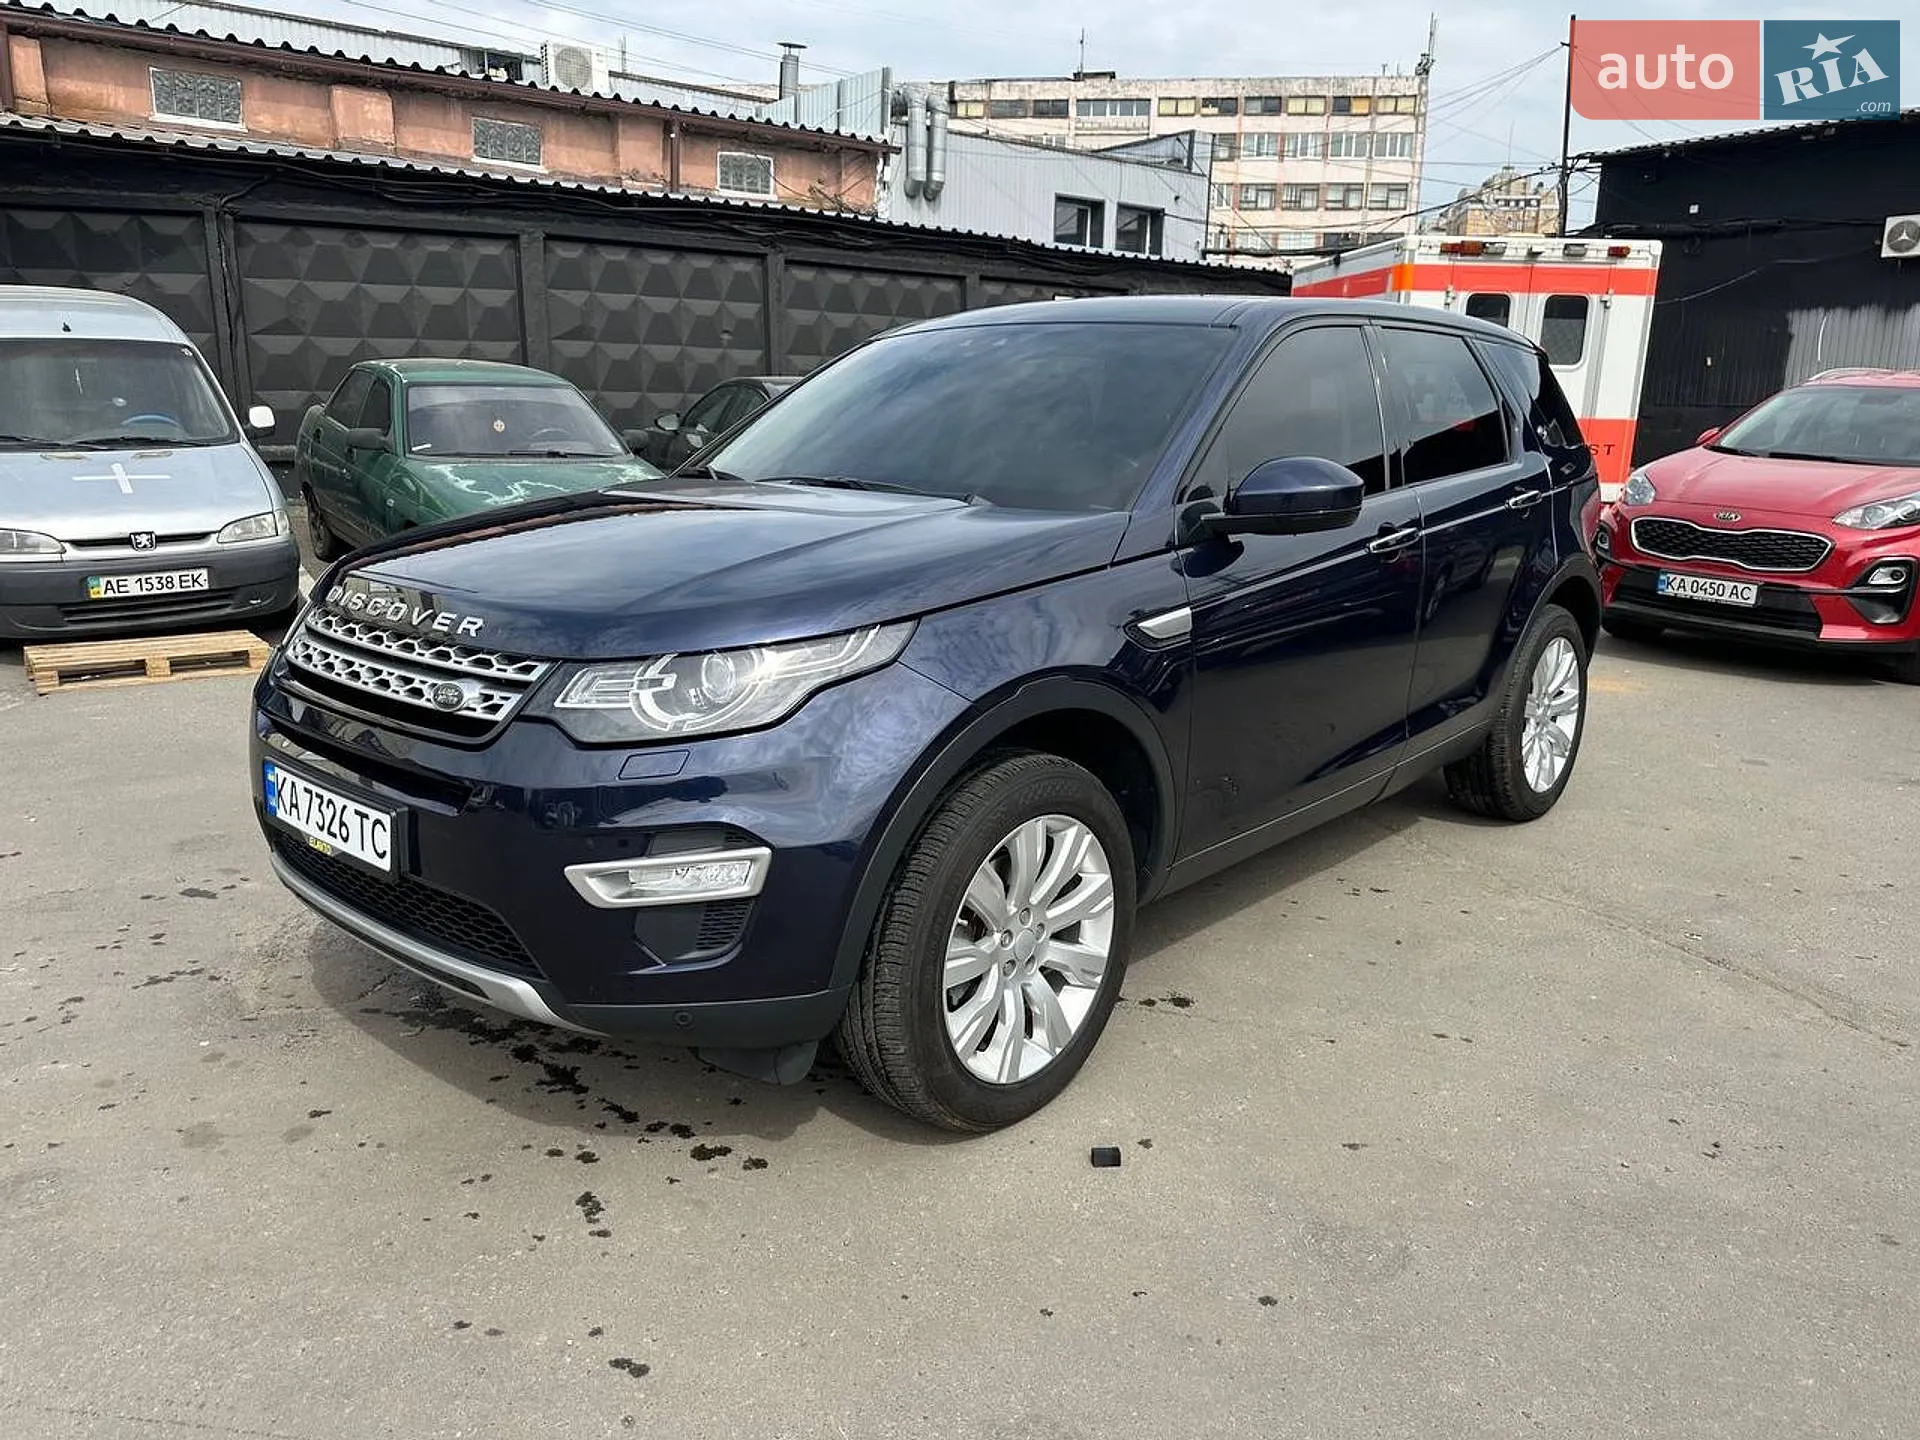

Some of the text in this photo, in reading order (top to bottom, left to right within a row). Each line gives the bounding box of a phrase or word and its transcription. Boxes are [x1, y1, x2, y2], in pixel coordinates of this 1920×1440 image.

[1586, 443, 1616, 456] ST
[104, 579, 129, 595] AE
[135, 575, 175, 592] 1538
[178, 573, 204, 589] EK
[1666, 576, 1751, 601] KA 0450 AC
[326, 585, 484, 637] DISCOVER
[276, 773, 387, 860] KA 7326 TC
